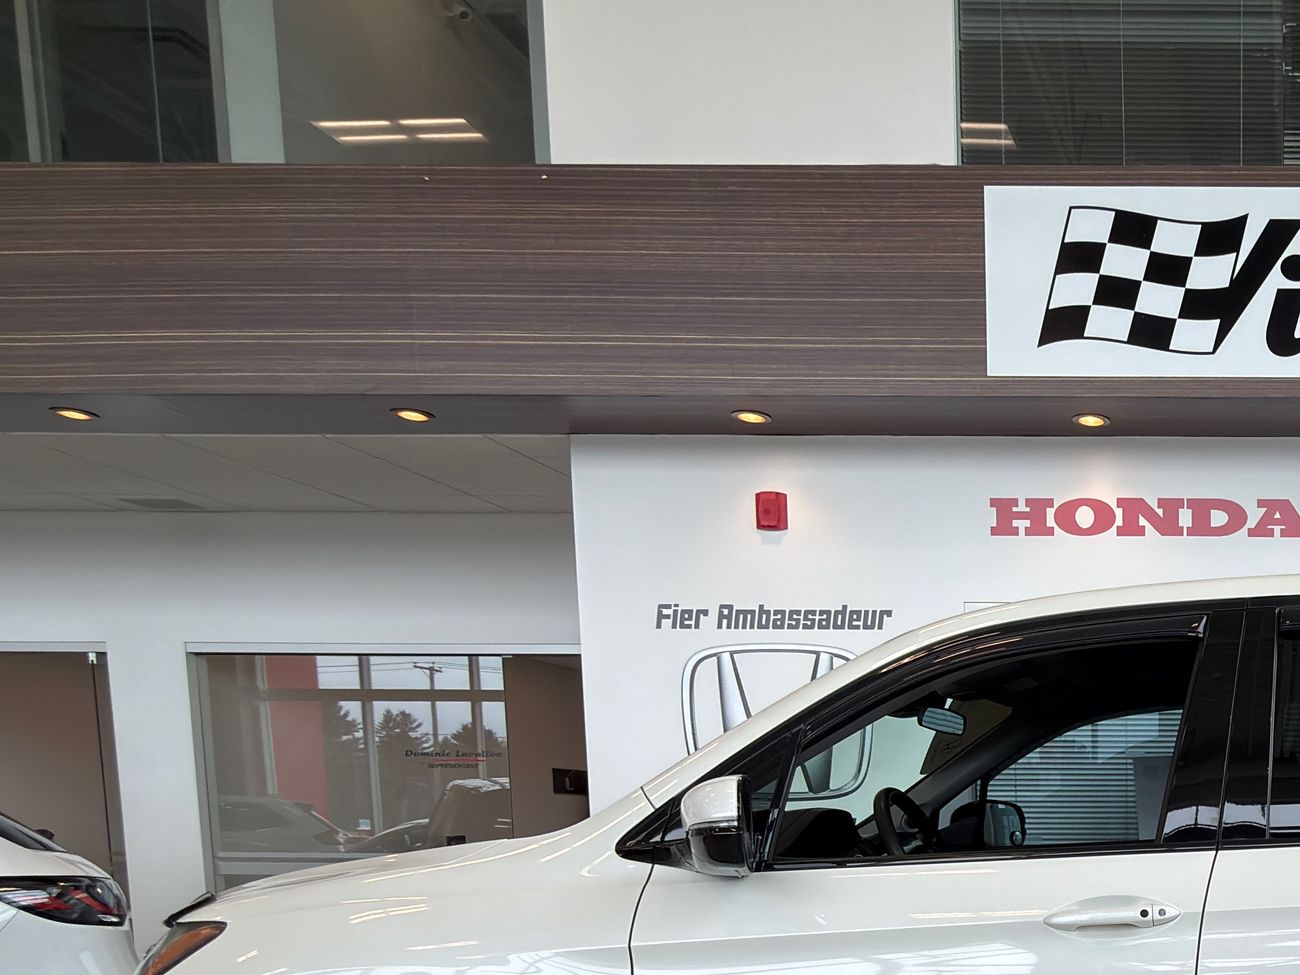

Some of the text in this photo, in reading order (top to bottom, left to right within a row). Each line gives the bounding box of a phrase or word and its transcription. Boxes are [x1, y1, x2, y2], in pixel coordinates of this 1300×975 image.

[655, 603, 893, 631] Fier Ambassadeur
[404, 749, 451, 758] Dominic
